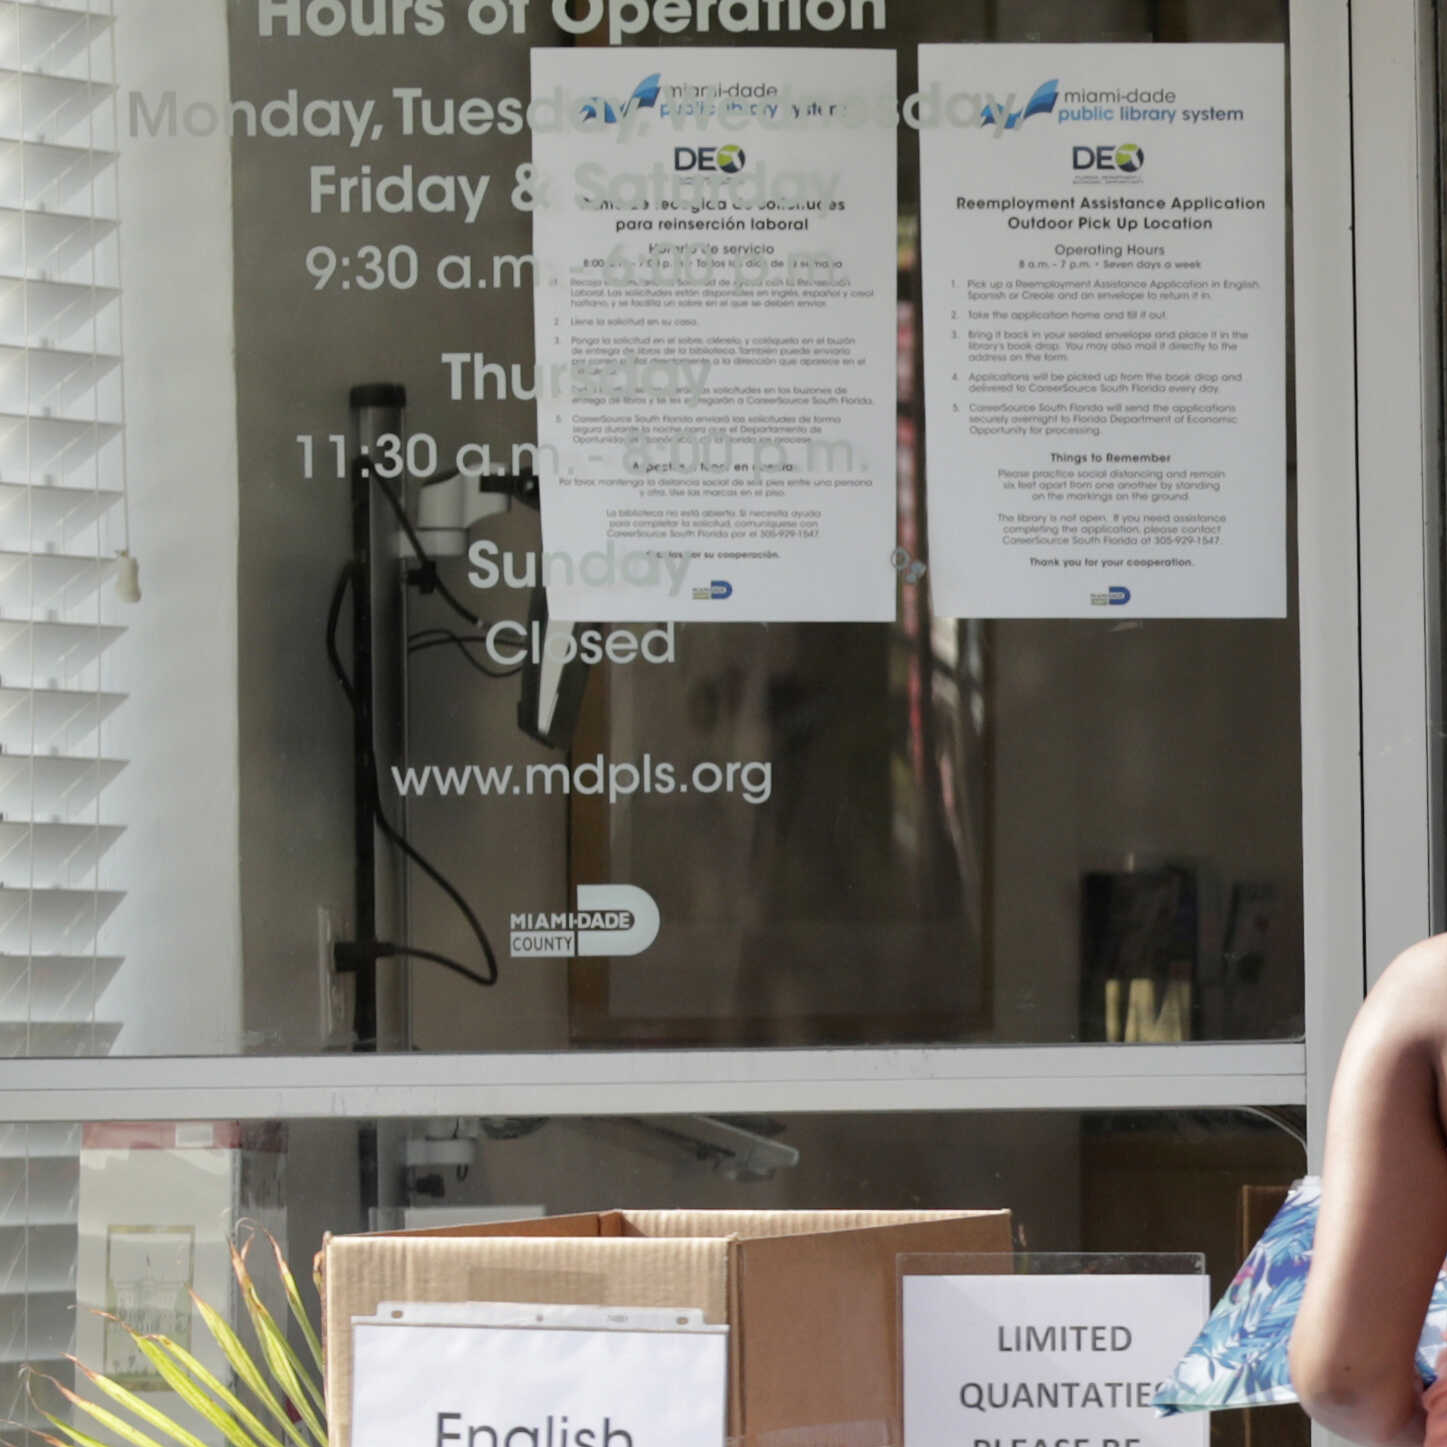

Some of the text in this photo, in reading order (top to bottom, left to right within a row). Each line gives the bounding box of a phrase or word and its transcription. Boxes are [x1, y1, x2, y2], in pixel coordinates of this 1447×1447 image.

[258, 0, 886, 45] Hours of Operation
[1064, 87, 1176, 104] miami-dade
[128, 90, 383, 146] Monday,
[1058, 106, 1244, 124] public library system
[311, 165, 489, 219] Friday
[956, 197, 1265, 213] Reemployment Assistance Application
[615, 217, 808, 233] para reinserción laboral
[1008, 217, 1213, 233] Outdoor Pick Up Location
[306, 246, 420, 290] 9:30
[295, 434, 437, 480] 11:30
[485, 619, 676, 665] Closed
[391, 753, 772, 803] www.mdpls.org
[509, 912, 632, 929] MIAMI-DADE
[511, 935, 574, 953] COUNTY
[997, 1325, 1133, 1353] LIMITED
